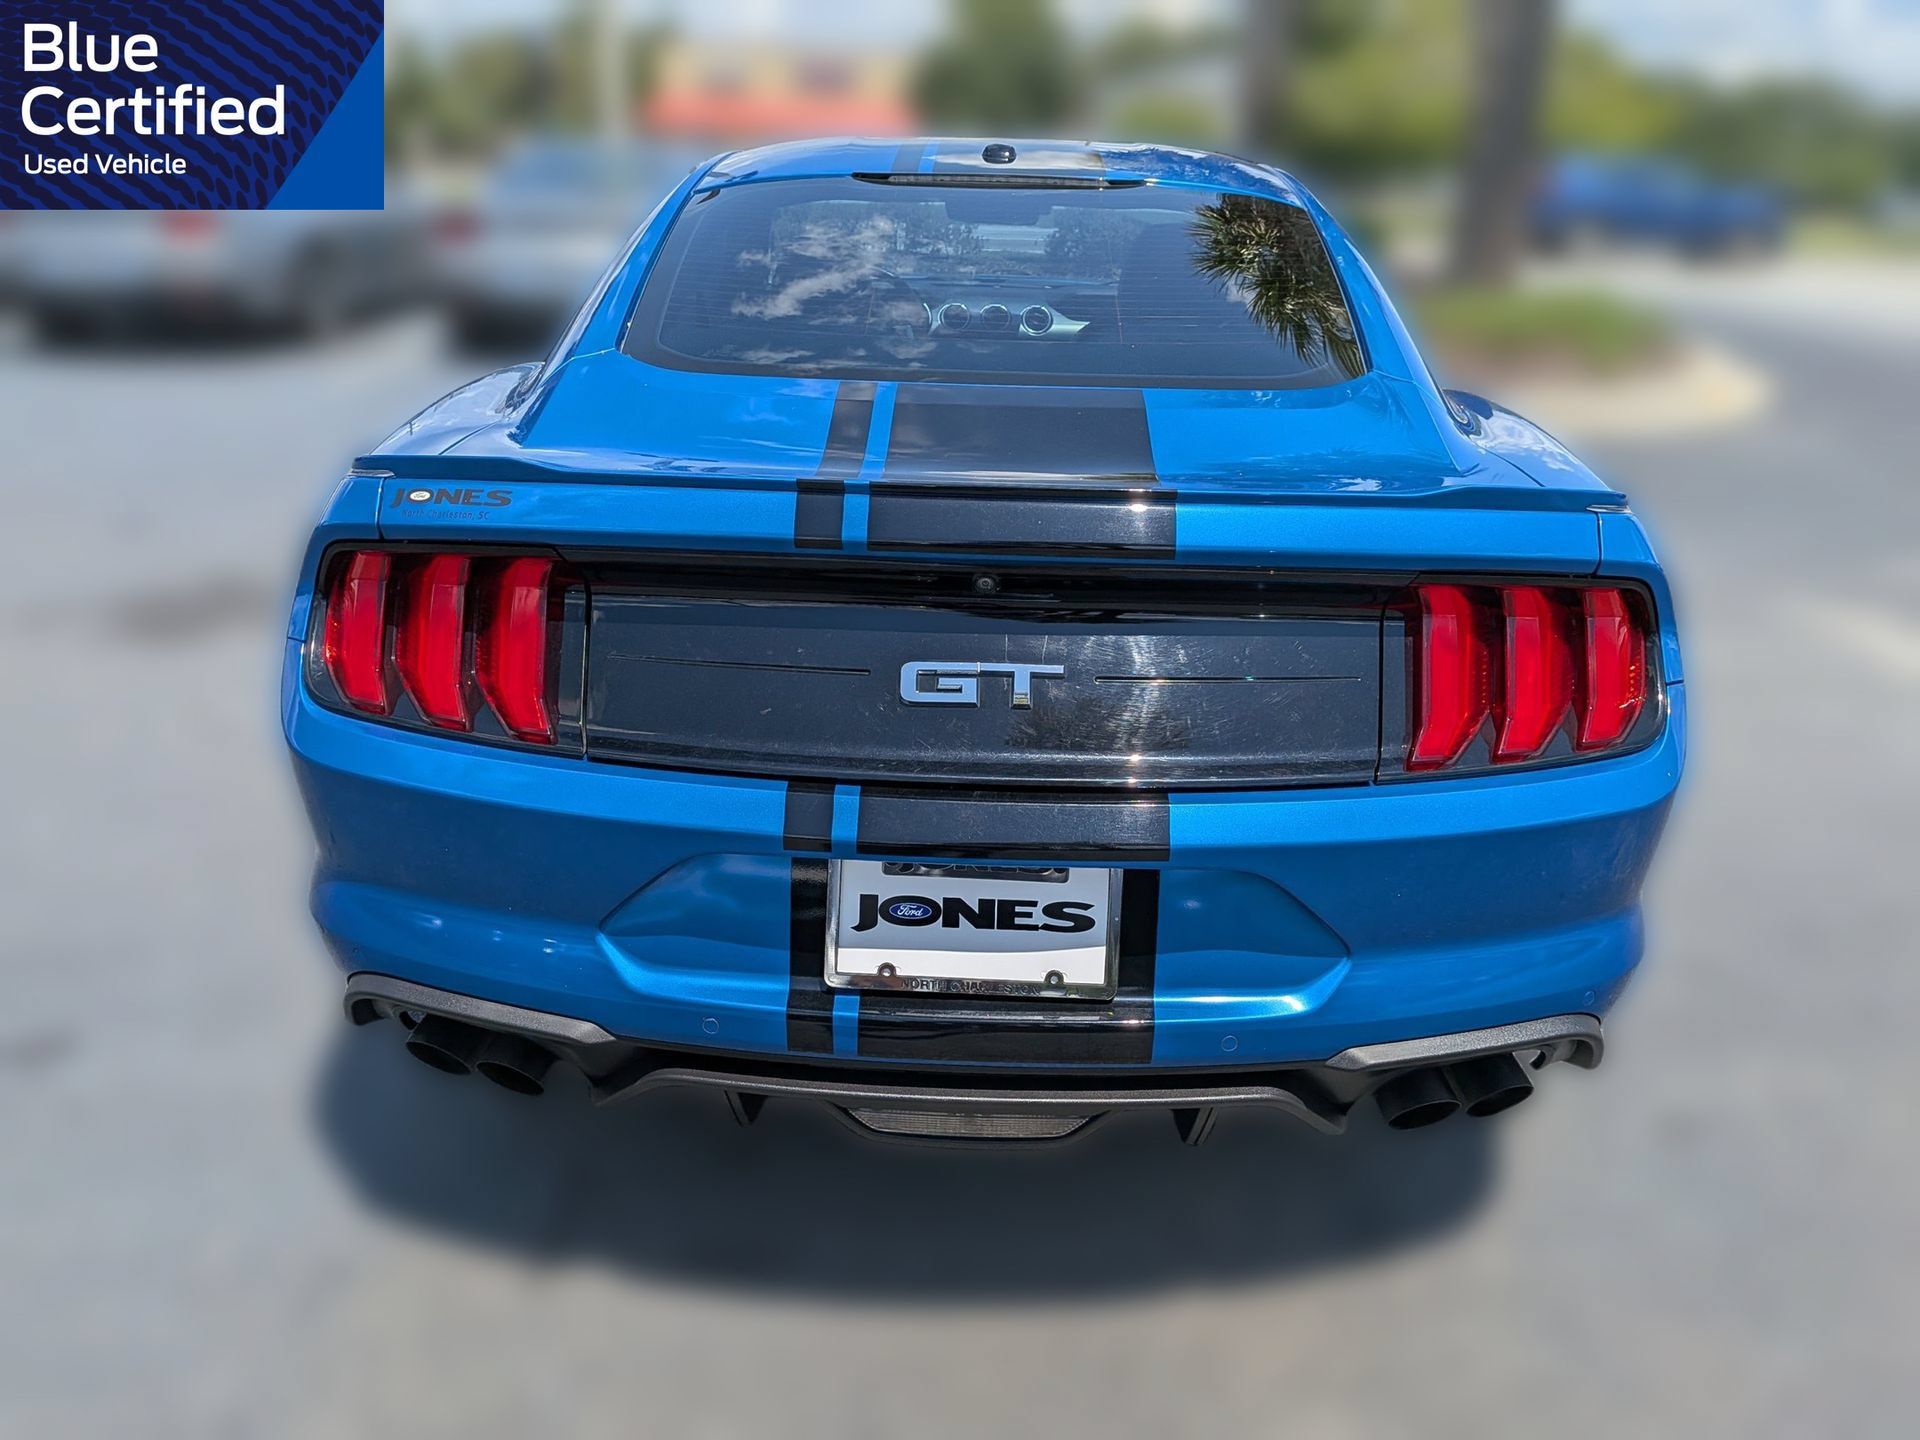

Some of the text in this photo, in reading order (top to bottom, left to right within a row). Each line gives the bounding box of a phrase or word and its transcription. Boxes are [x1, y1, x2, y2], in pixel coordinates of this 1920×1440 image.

[392, 488, 512, 508] JONES
[478, 511, 490, 520] SC
[900, 661, 1066, 710] GT
[850, 893, 1097, 934] JONES
[896, 904, 924, 918] Ford
[900, 978, 947, 992] NORTH
